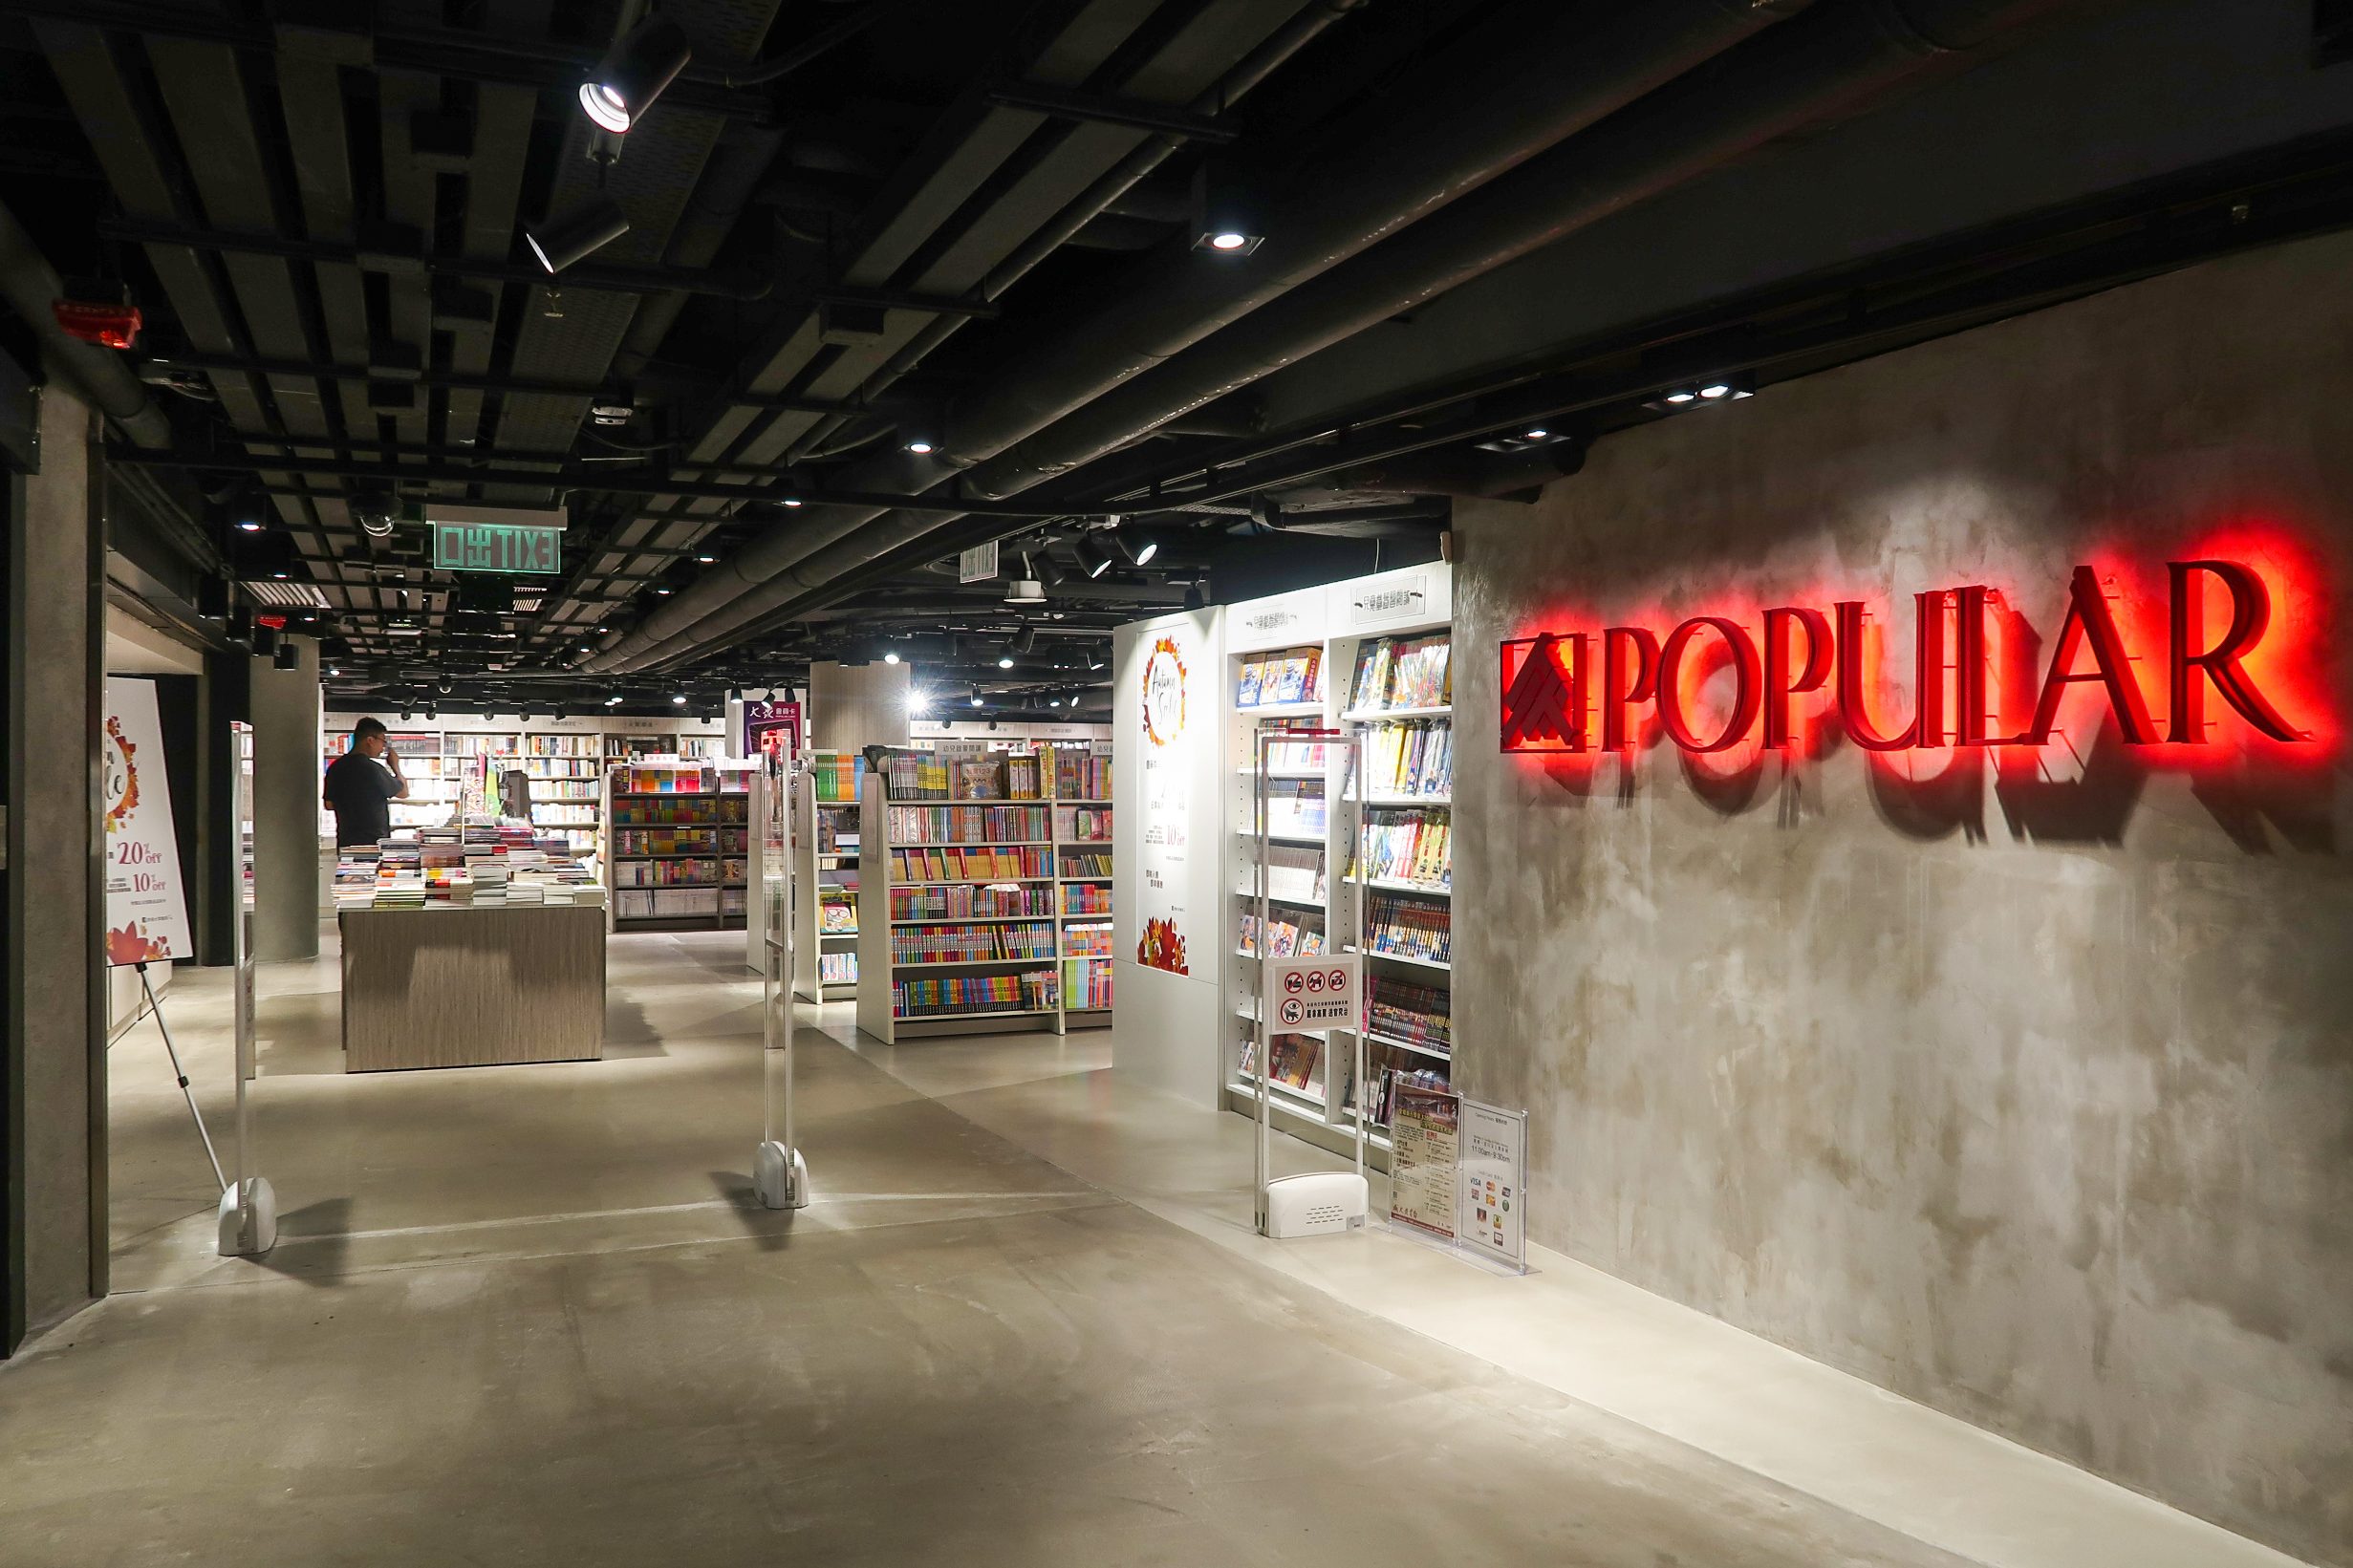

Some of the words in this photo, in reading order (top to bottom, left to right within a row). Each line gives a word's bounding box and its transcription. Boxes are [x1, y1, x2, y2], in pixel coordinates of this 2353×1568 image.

[1603, 560, 2316, 753] POPULAR
[1153, 664, 1176, 696] Autumn
[144, 852, 162, 864] off
[1470, 1176, 1481, 1187] VISA
